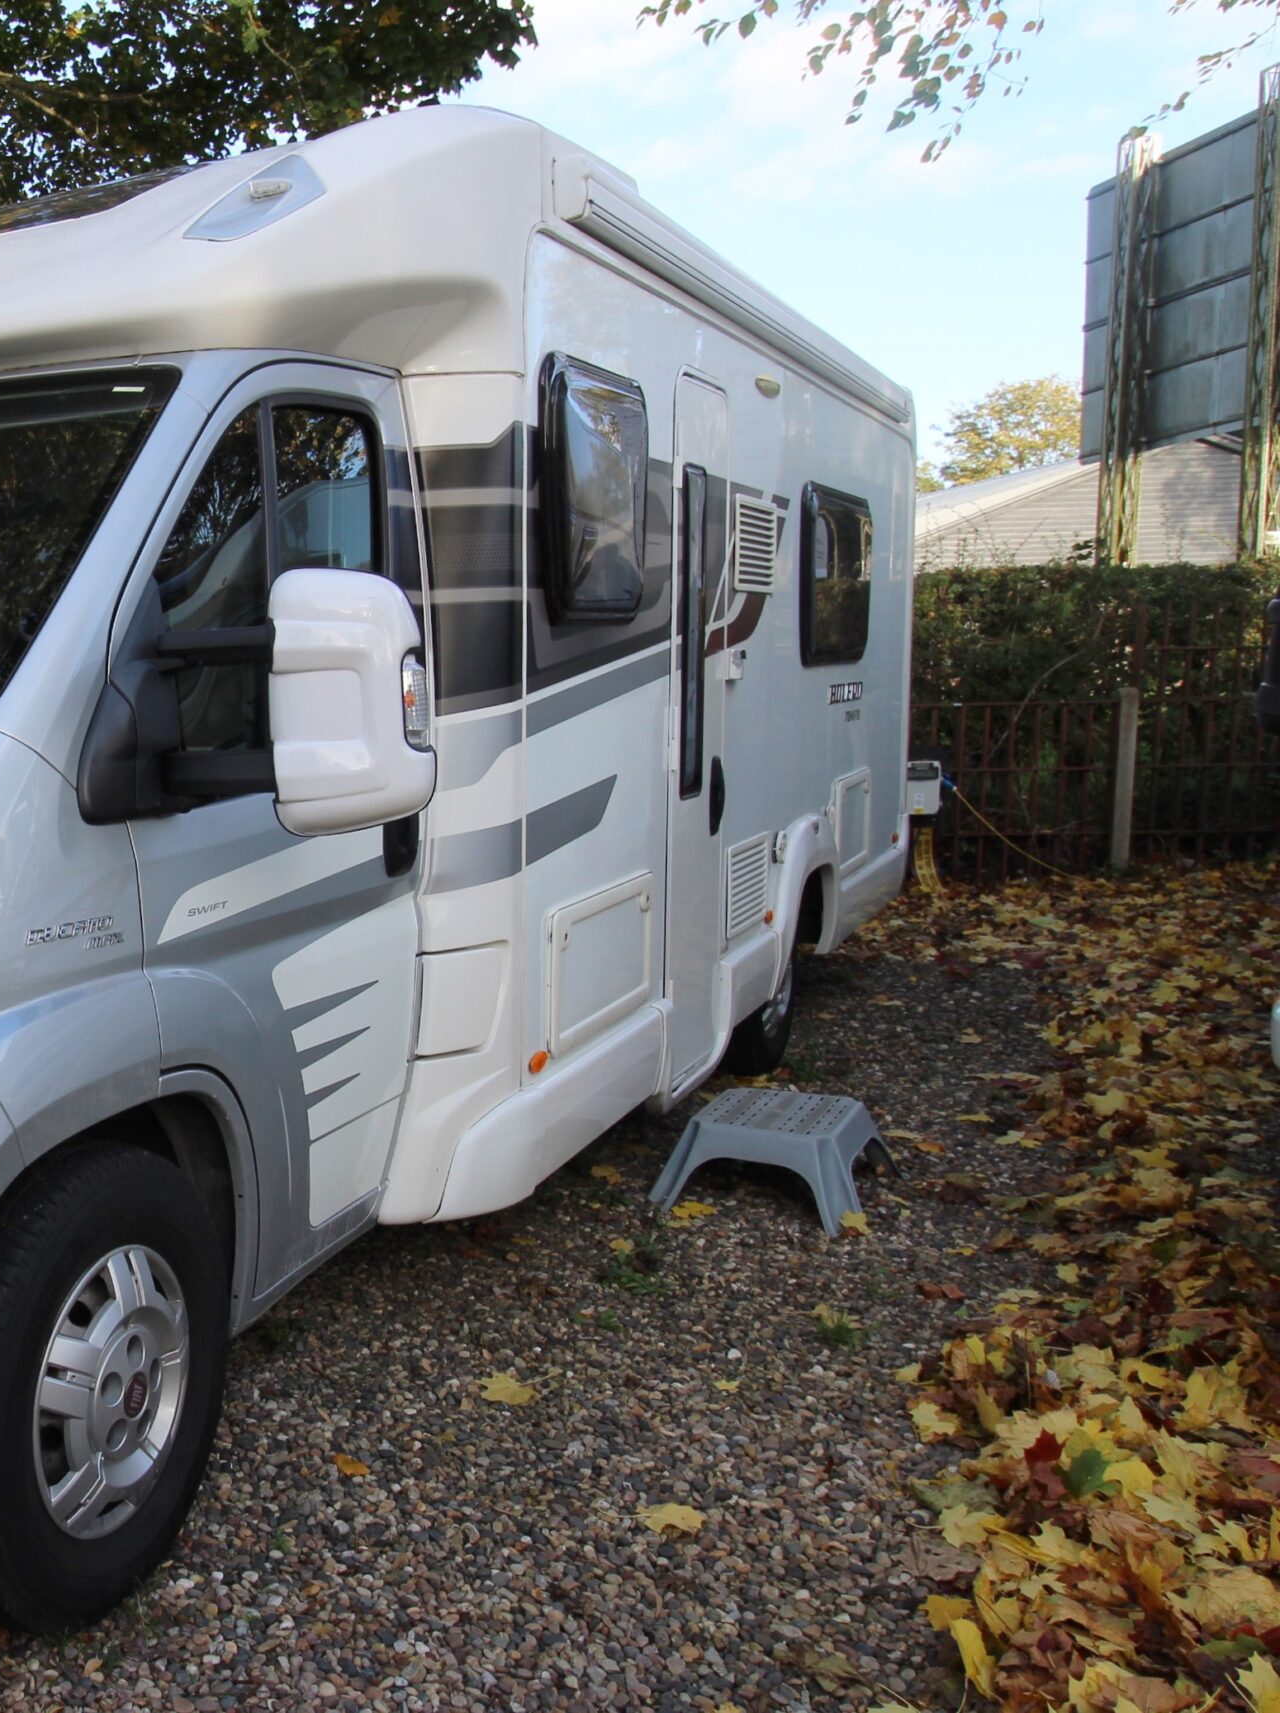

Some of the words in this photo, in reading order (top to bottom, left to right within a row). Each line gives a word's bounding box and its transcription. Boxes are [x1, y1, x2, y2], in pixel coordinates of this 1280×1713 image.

[187, 900, 229, 917] SWIFT
[25, 915, 114, 947] DUCATO
[130, 1383, 143, 1408] FIAT
